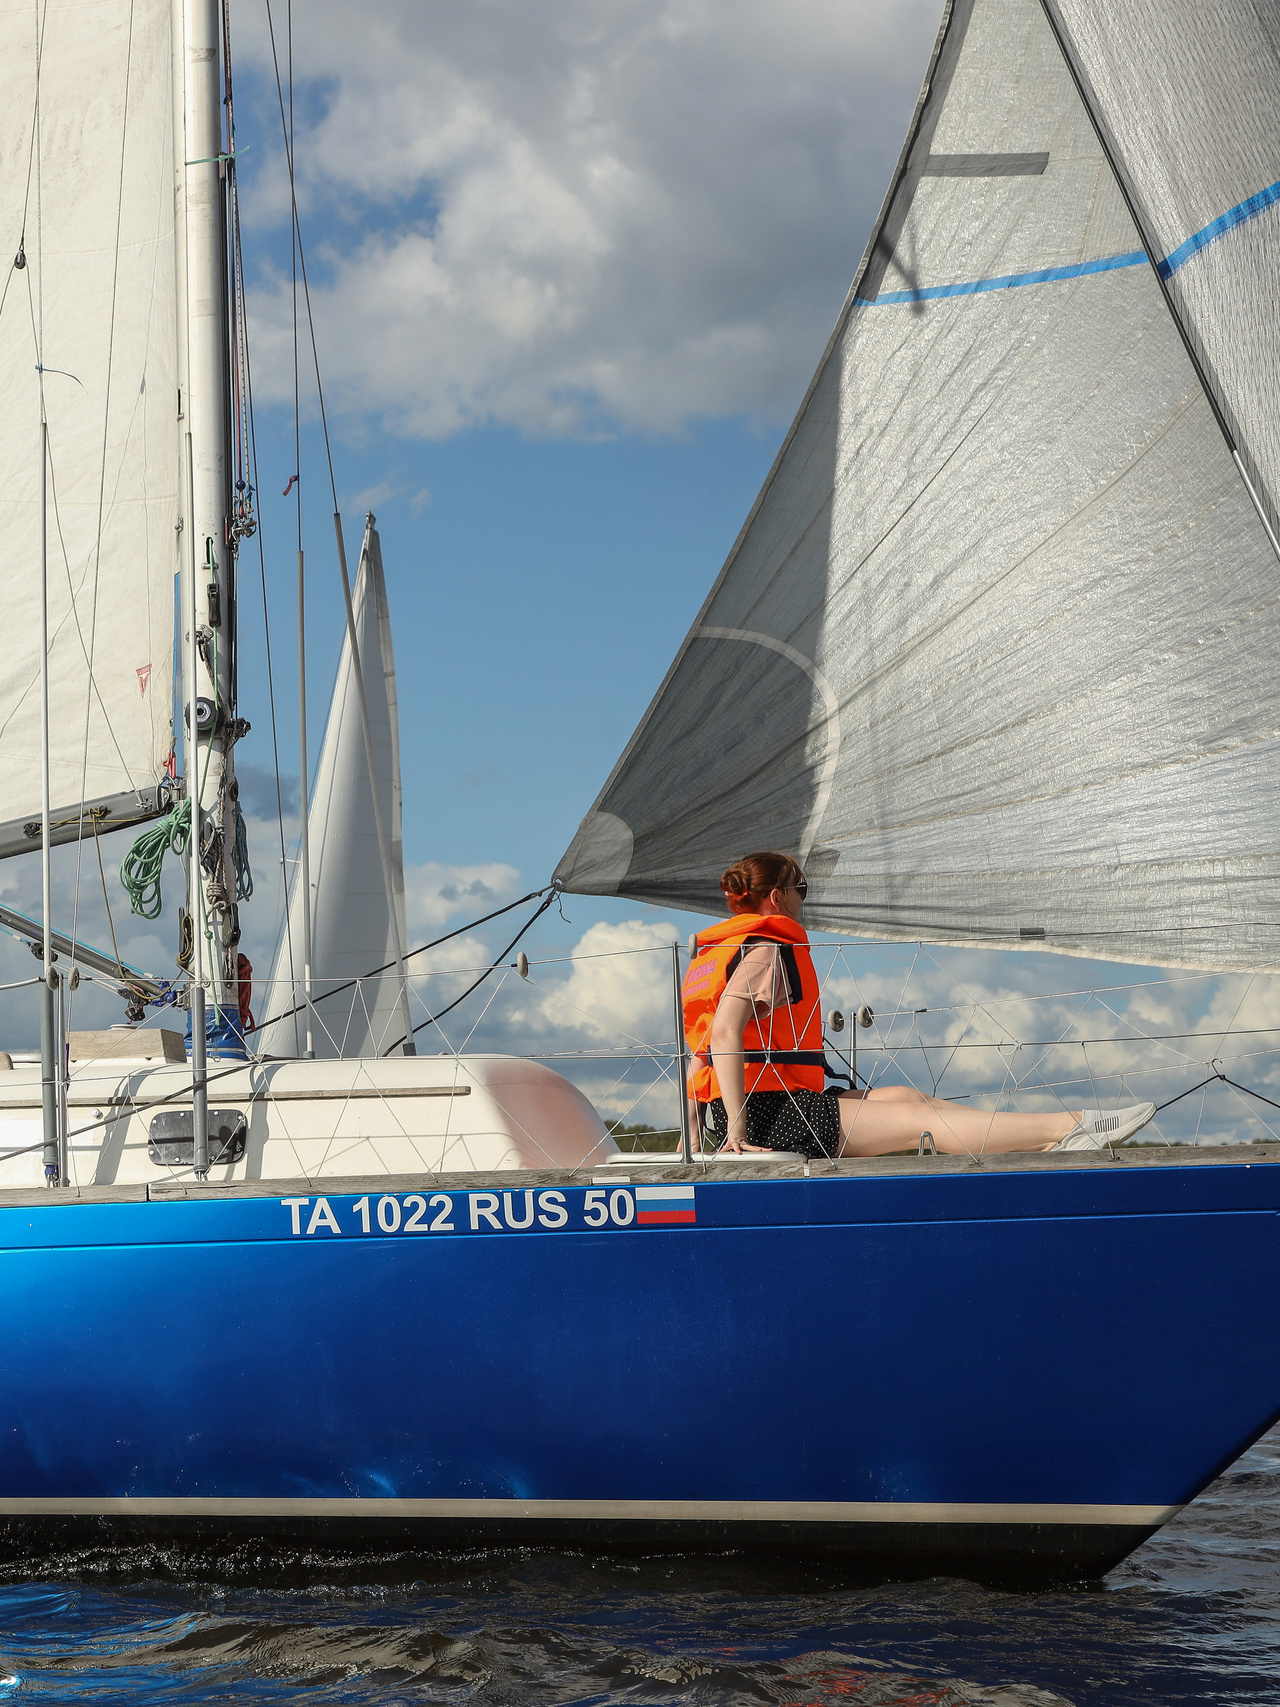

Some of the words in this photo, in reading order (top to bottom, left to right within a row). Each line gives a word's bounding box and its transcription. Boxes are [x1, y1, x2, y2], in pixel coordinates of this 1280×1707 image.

[281, 1197, 342, 1235] TA
[352, 1193, 455, 1233] 1022
[468, 1189, 570, 1230] RUS
[583, 1188, 635, 1228] 50
